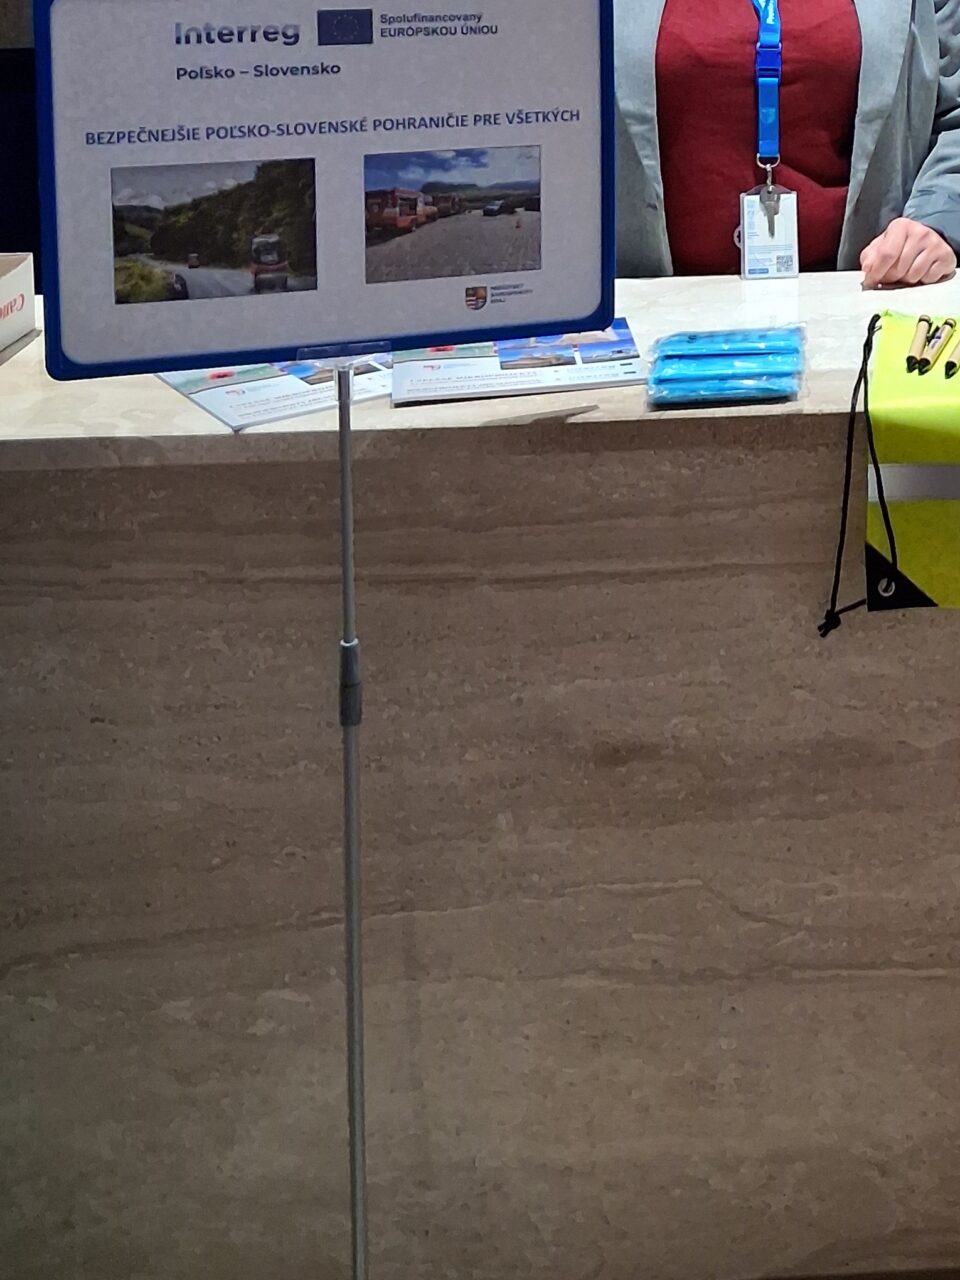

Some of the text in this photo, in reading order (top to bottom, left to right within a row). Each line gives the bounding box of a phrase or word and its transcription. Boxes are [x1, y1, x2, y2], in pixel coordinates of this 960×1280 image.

[175, 22, 300, 46] Interreg
[380, 23, 498, 38] EURÓPSKOU ÚNIOU
[253, 62, 341, 78] Slovensko
[85, 107, 581, 145] BEZPEČNEJŠIE POĽSKO-SLOVENSKÉ POHRANIČIE PRE VŠETKÝCH
